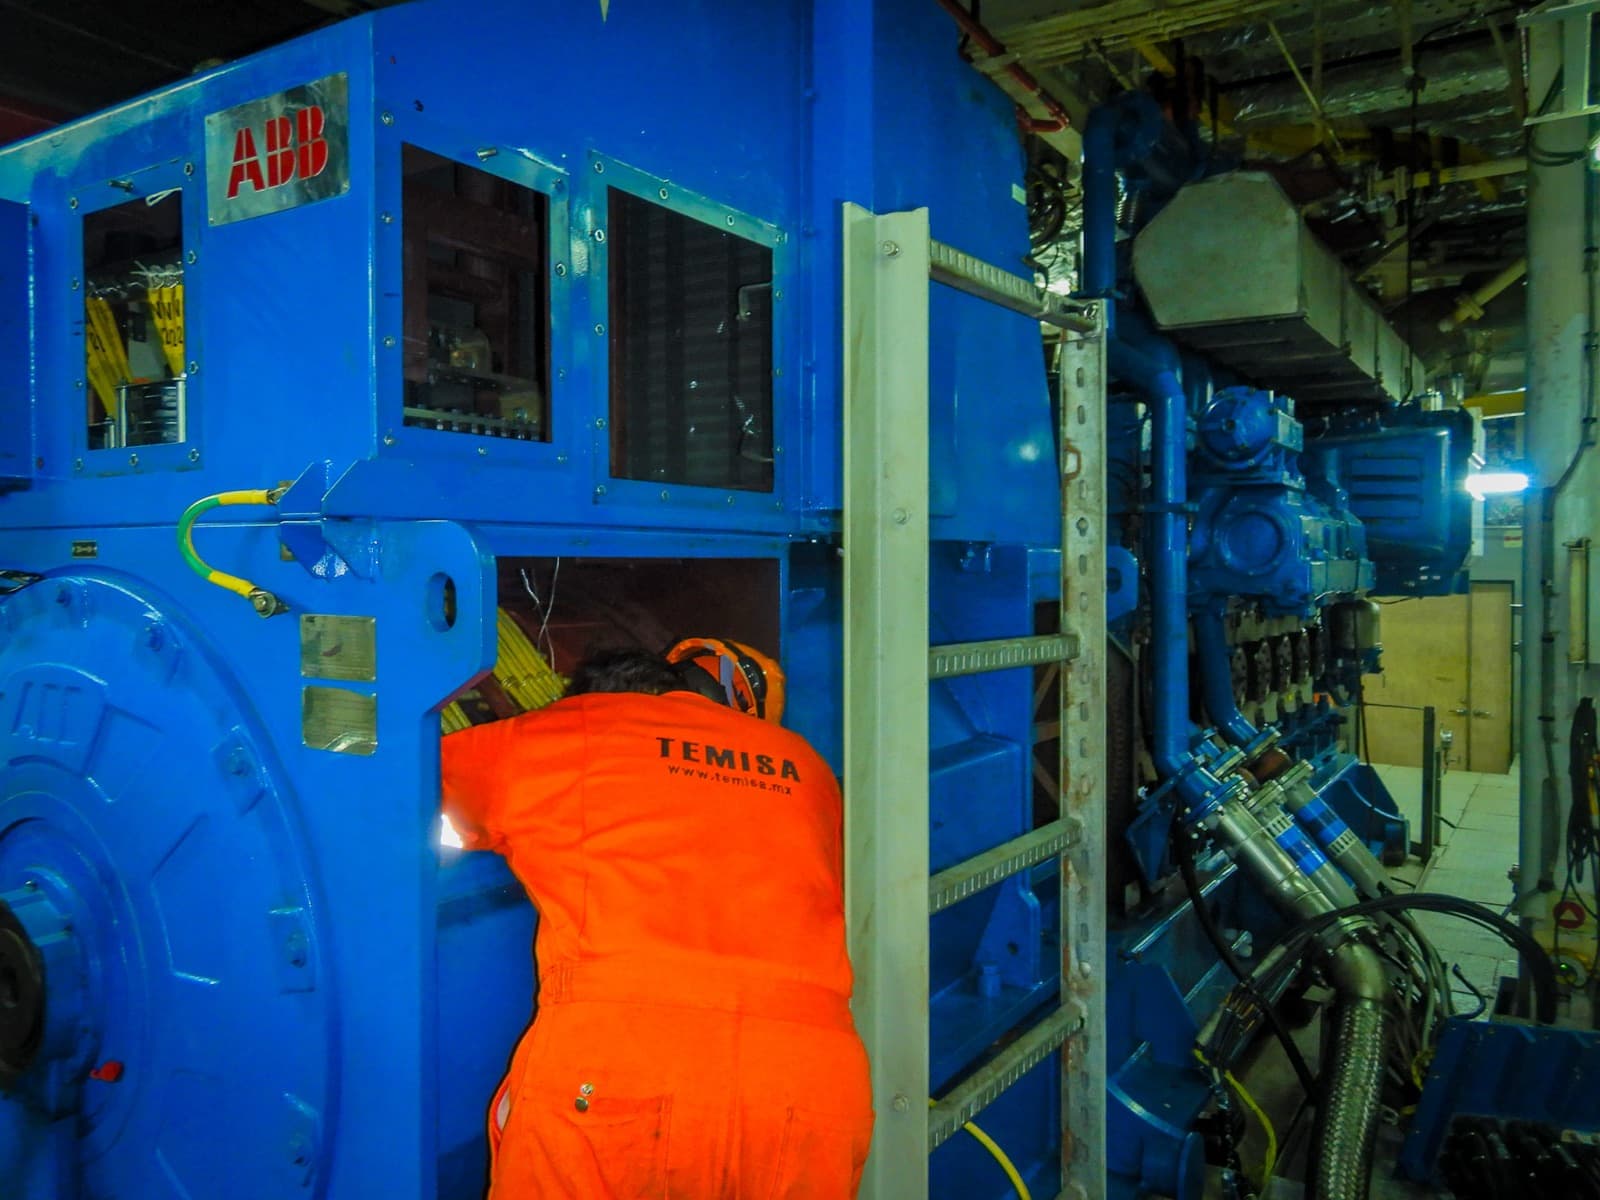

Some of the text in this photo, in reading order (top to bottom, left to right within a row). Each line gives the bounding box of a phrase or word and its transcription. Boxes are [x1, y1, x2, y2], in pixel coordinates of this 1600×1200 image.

[227, 105, 329, 200] ABB
[656, 737, 801, 783] TEMISA
[668, 765, 792, 795] www.temisa.mx
